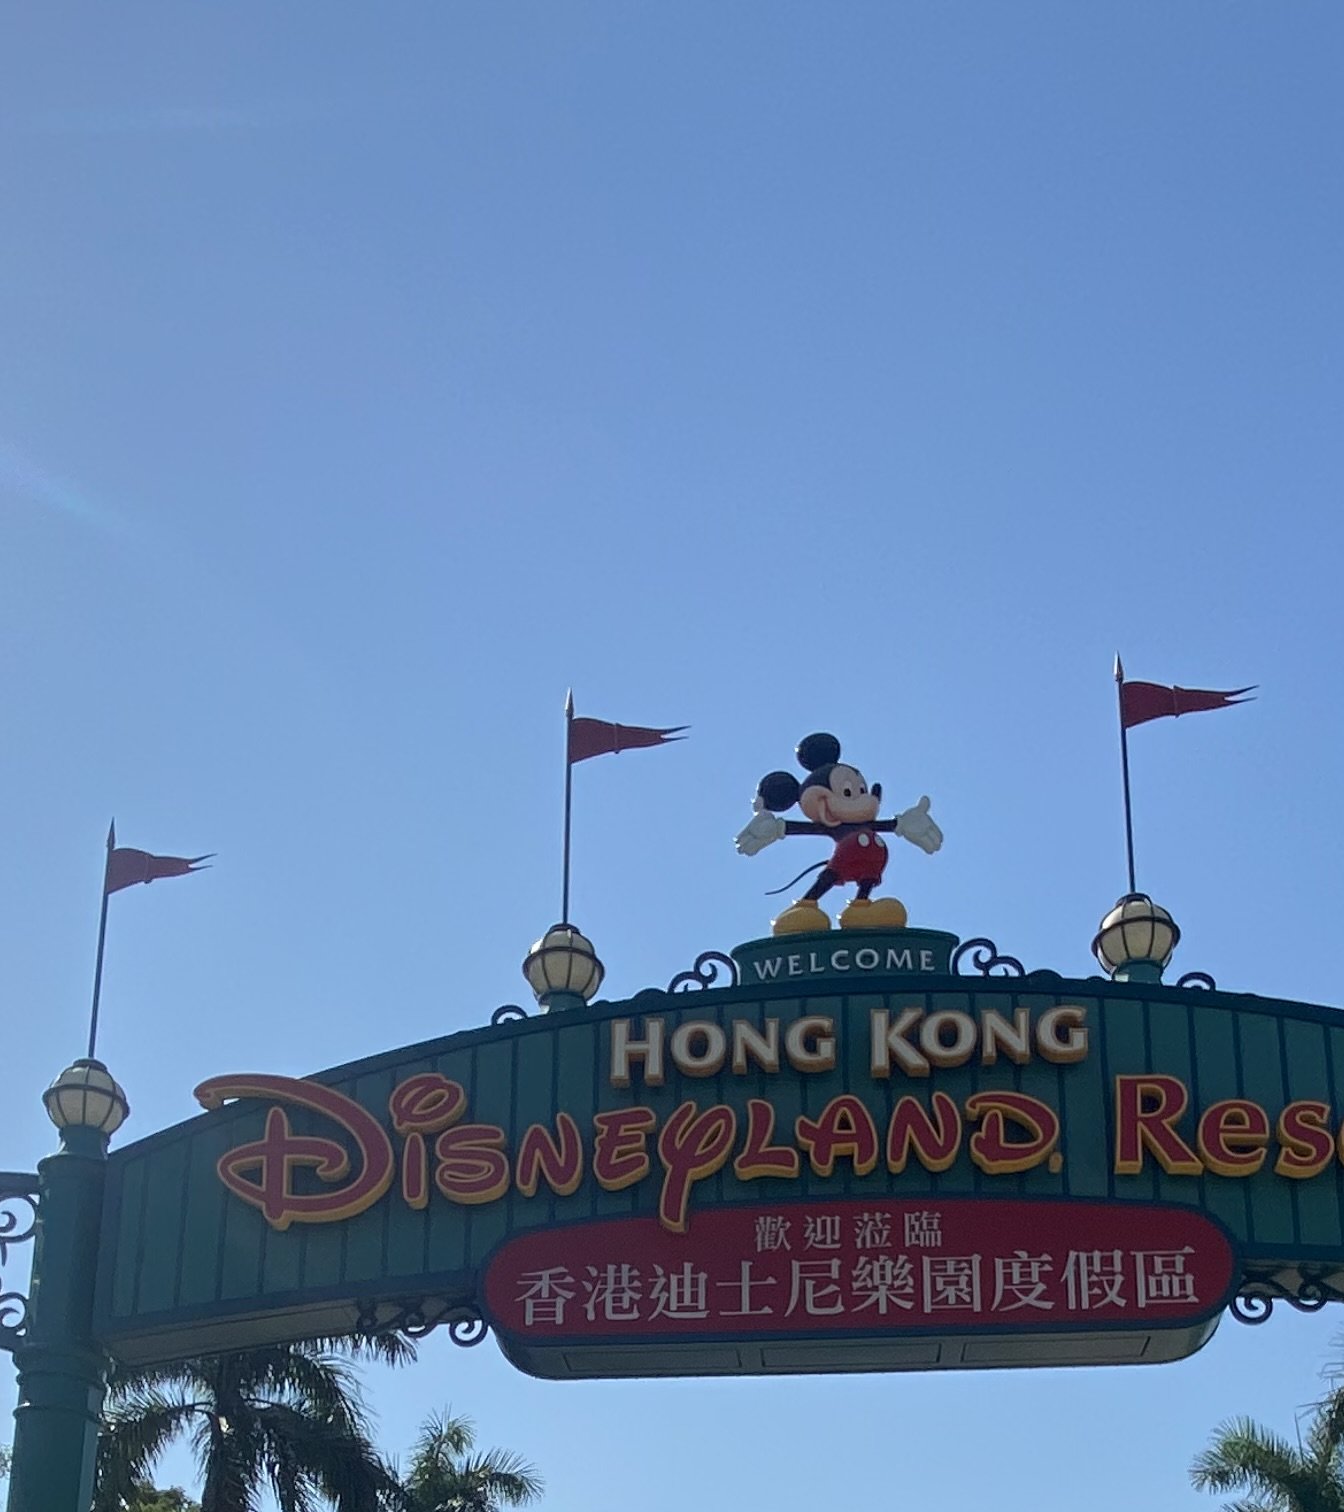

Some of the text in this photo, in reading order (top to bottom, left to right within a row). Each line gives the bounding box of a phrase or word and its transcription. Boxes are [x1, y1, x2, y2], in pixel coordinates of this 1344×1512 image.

[753, 947, 936, 980] WELCOME
[609, 1005, 1089, 1088] HONG KONG
[753, 1211, 944, 1252] 歡迎蒞臨
[513, 1245, 1201, 1326] 香港迪士尼樂園度假區
